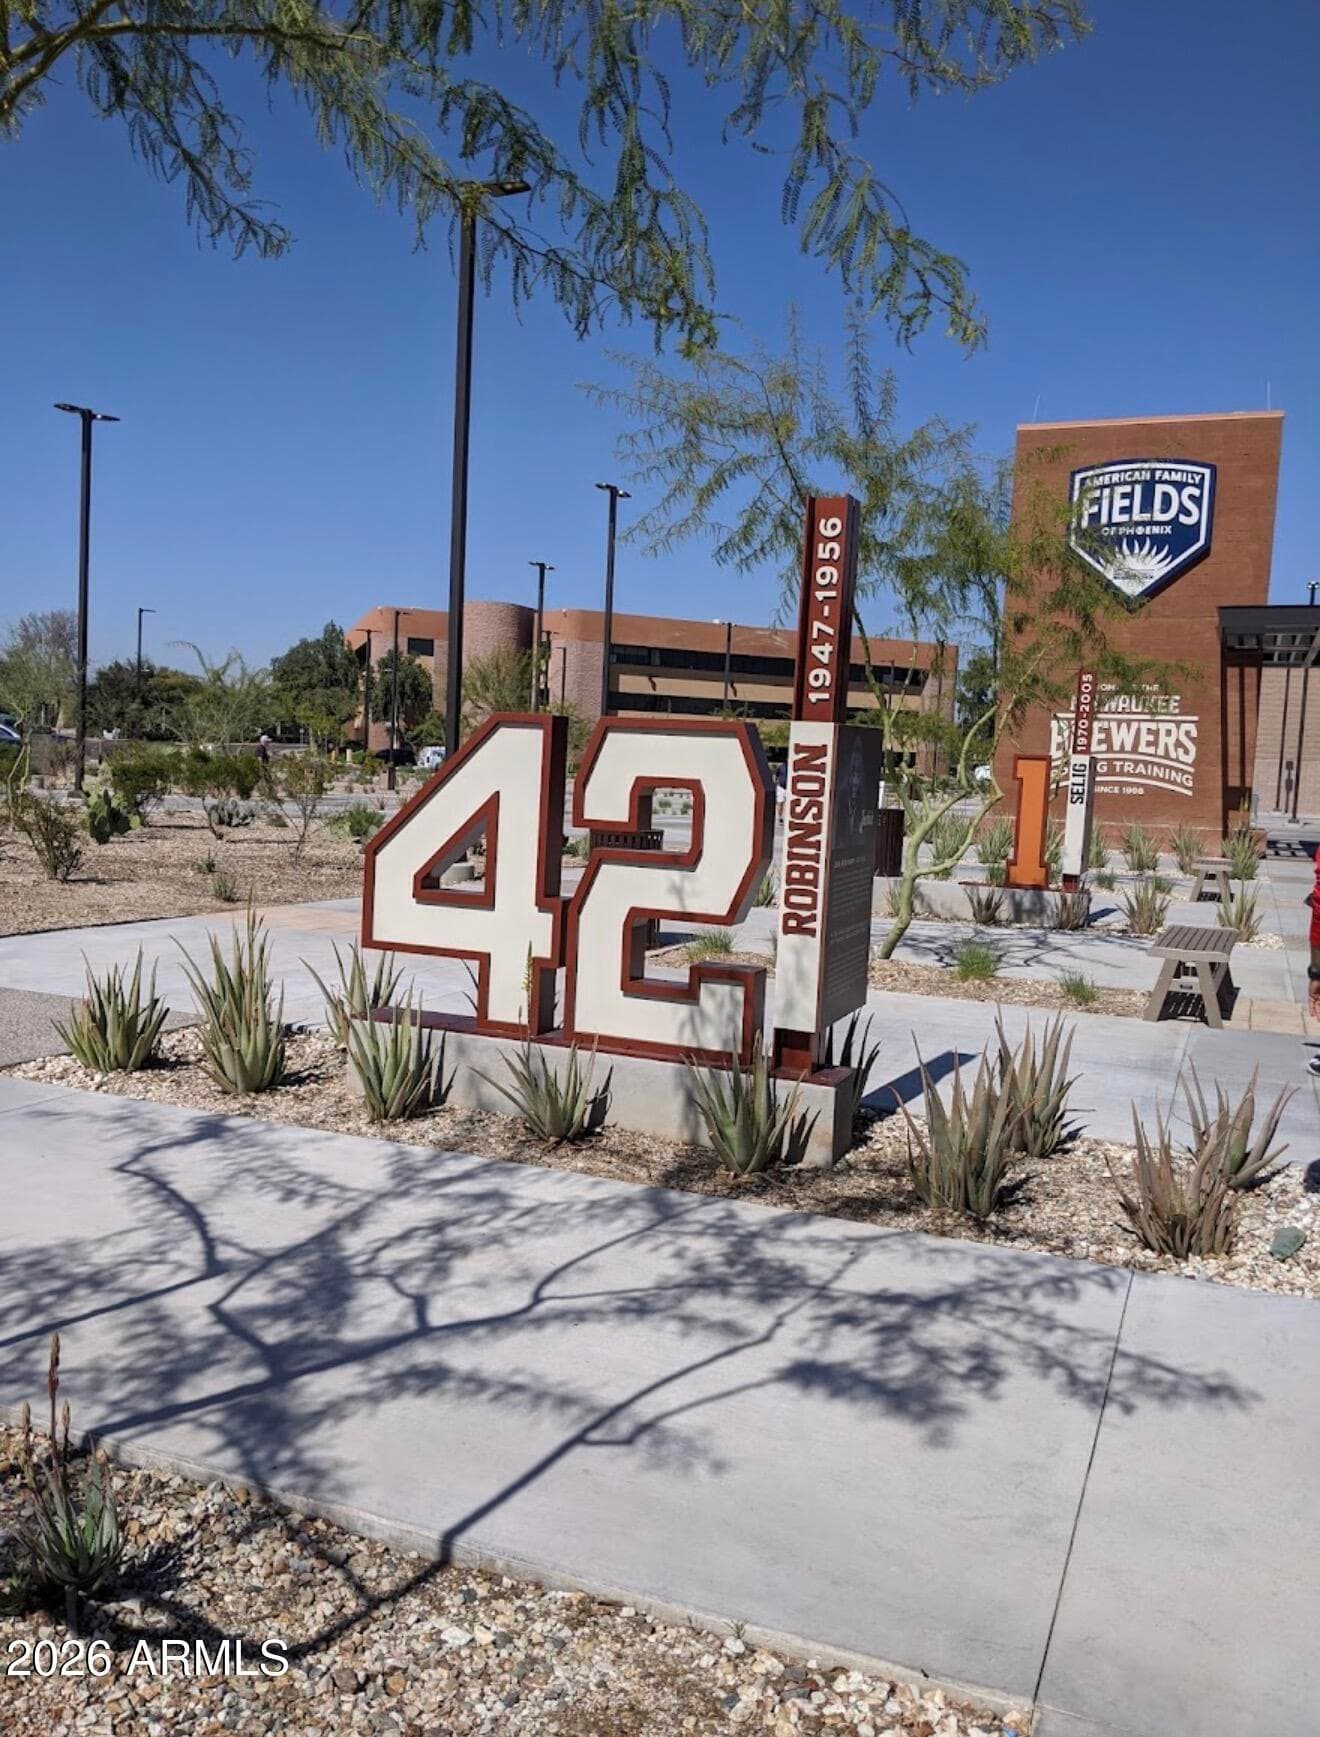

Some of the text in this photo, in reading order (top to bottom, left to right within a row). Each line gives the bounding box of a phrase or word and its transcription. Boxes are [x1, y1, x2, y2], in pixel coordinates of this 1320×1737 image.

[1084, 470, 1203, 488] AMERICAN FAMILY
[1081, 483, 1201, 529] FIELDS
[1118, 525, 1172, 535] PHOENIX
[807, 516, 843, 705] 1947-1956
[1076, 673, 1093, 752] 1970-2005
[1049, 720, 1198, 764] BEWERS
[1070, 763, 1087, 804] SELIG
[1113, 760, 1193, 787] TRAINING
[782, 743, 827, 938] ROBINSON
[1006, 754, 1052, 889] 1
[361, 712, 774, 1065] 42
